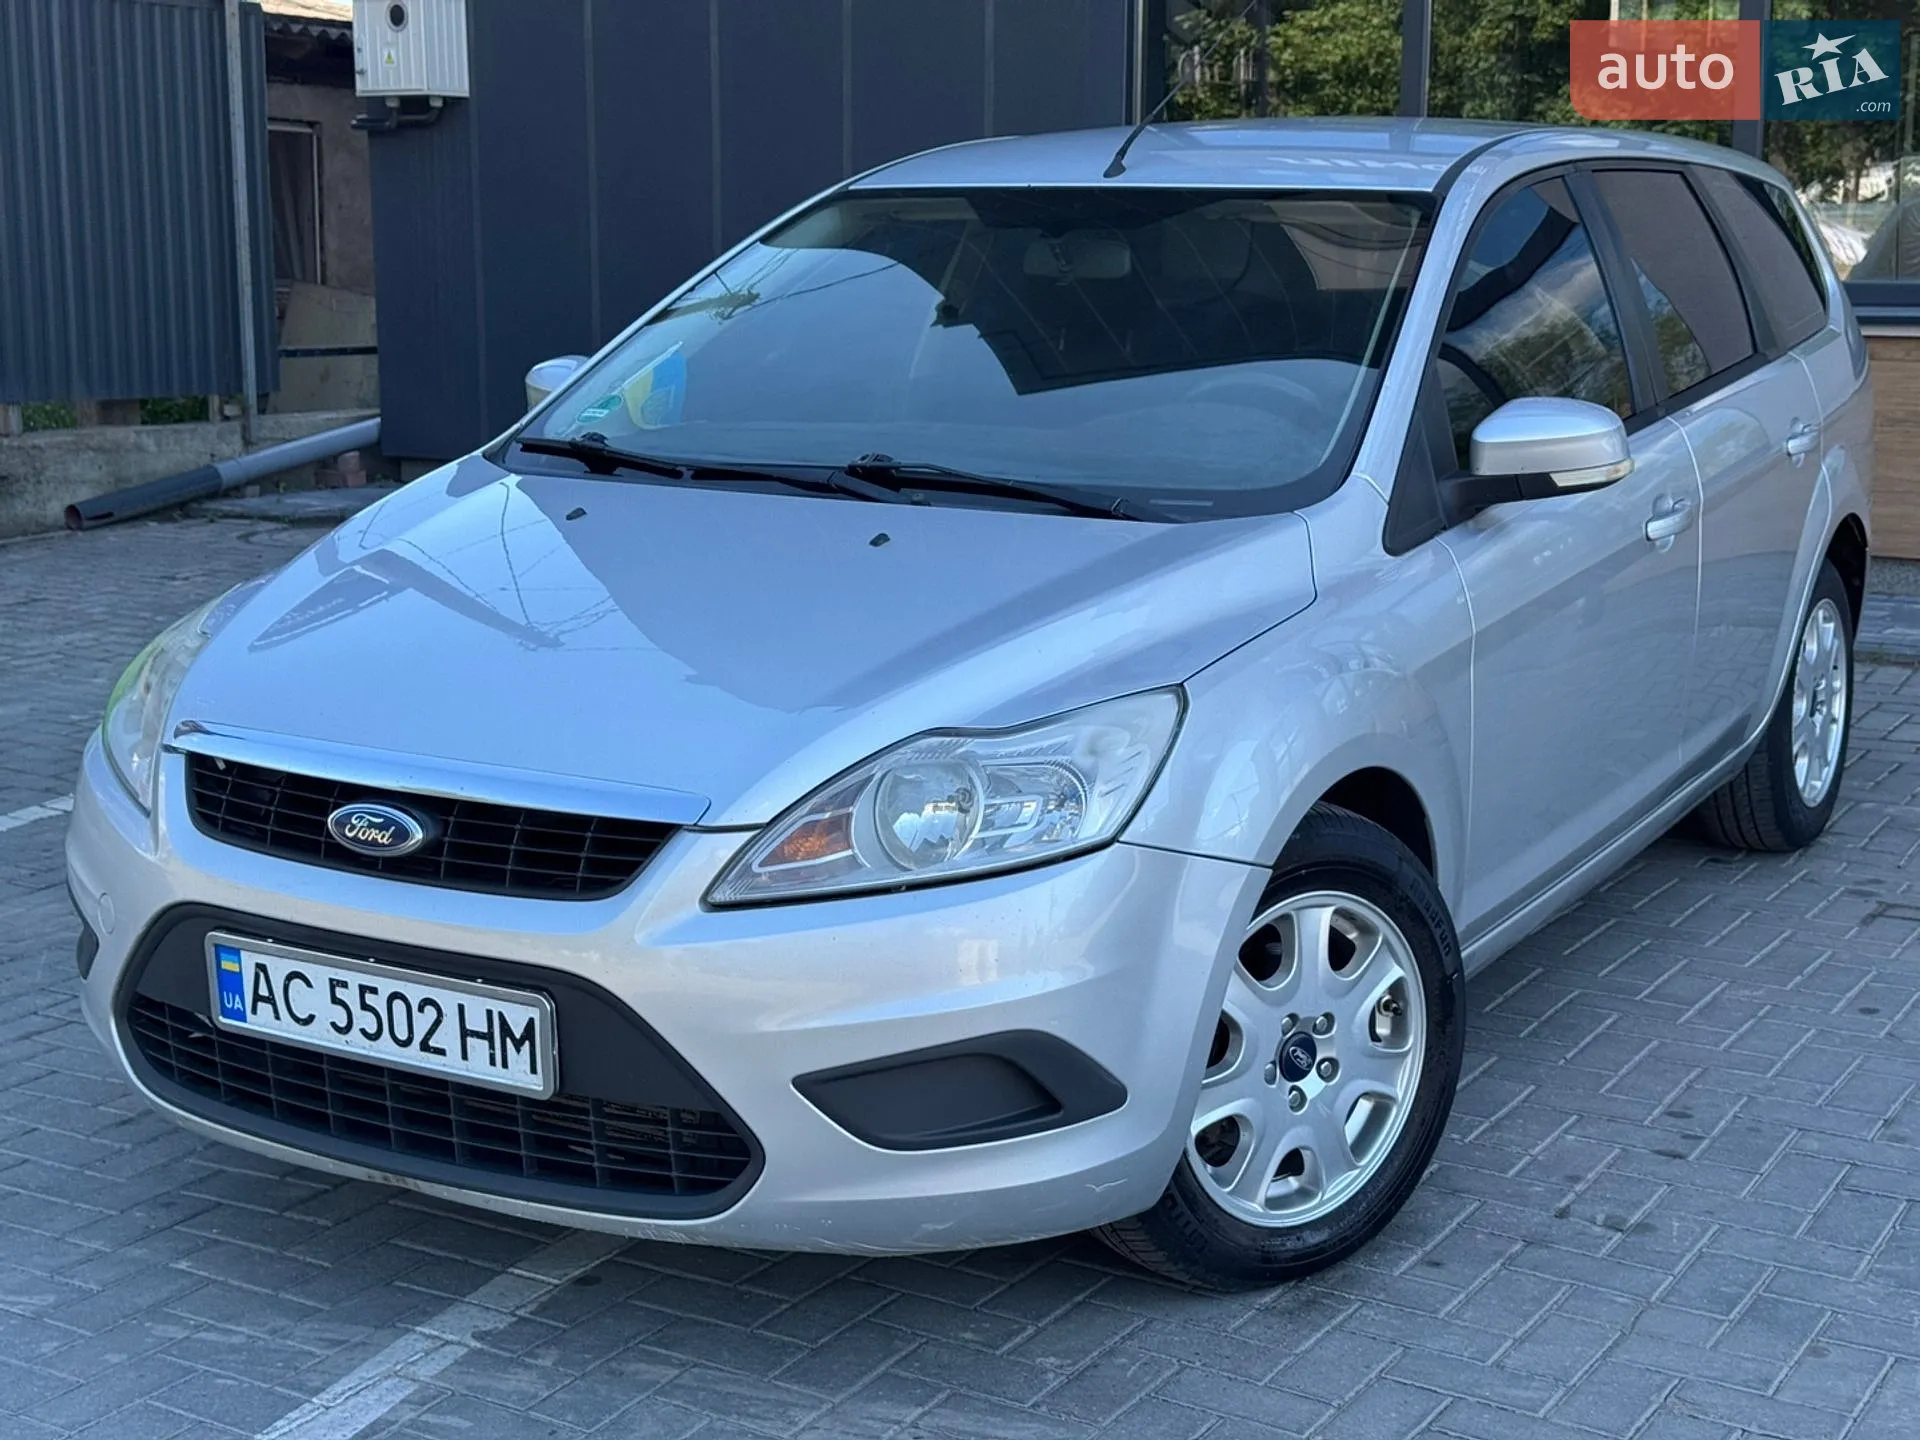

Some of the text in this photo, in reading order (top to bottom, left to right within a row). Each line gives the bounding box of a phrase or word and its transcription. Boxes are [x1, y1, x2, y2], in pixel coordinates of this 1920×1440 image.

[345, 813, 396, 845] Ford
[223, 990, 244, 1012] UA
[250, 962, 538, 1076] AC 5502 HM
